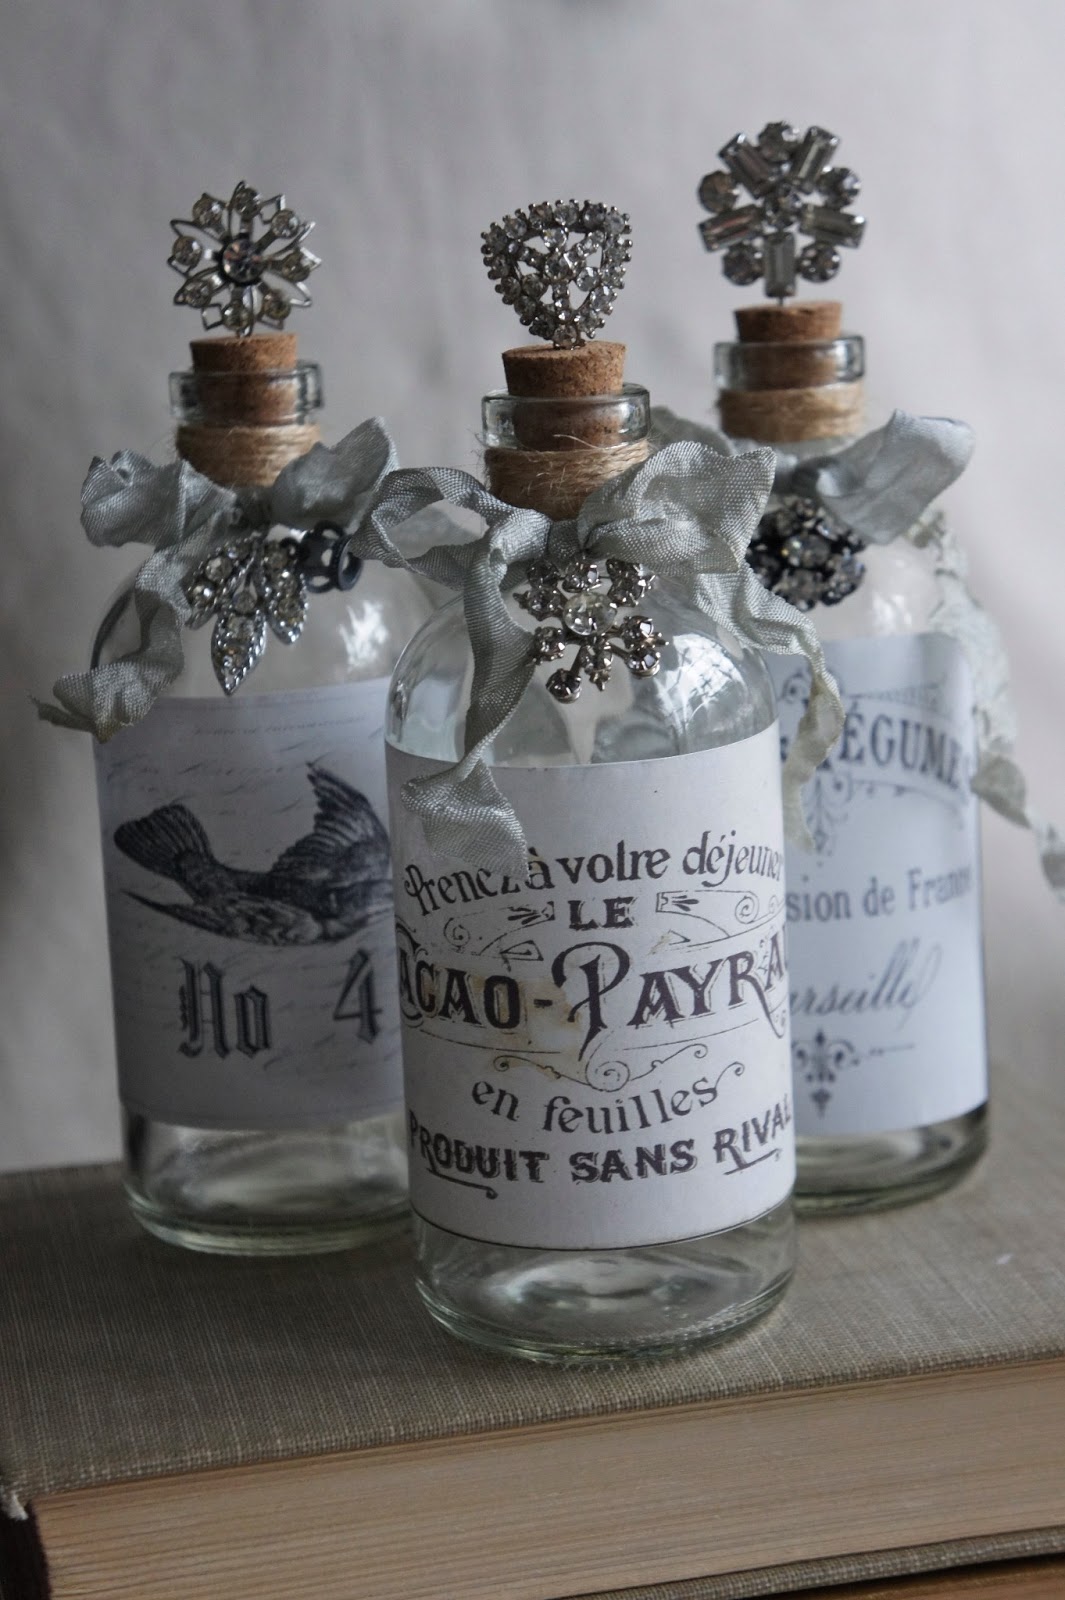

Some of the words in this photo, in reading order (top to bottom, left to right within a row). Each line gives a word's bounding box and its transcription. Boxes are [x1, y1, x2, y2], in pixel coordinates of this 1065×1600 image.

[568, 896, 634, 930] LE
[786, 875, 852, 922] sion
[863, 876, 895, 918] de
[332, 948, 383, 1045] 4
[471, 1081, 520, 1122] en
[542, 1061, 745, 1135] feuilles
[408, 1109, 550, 1199] PRODUIT
[569, 1138, 698, 1184] SANS
